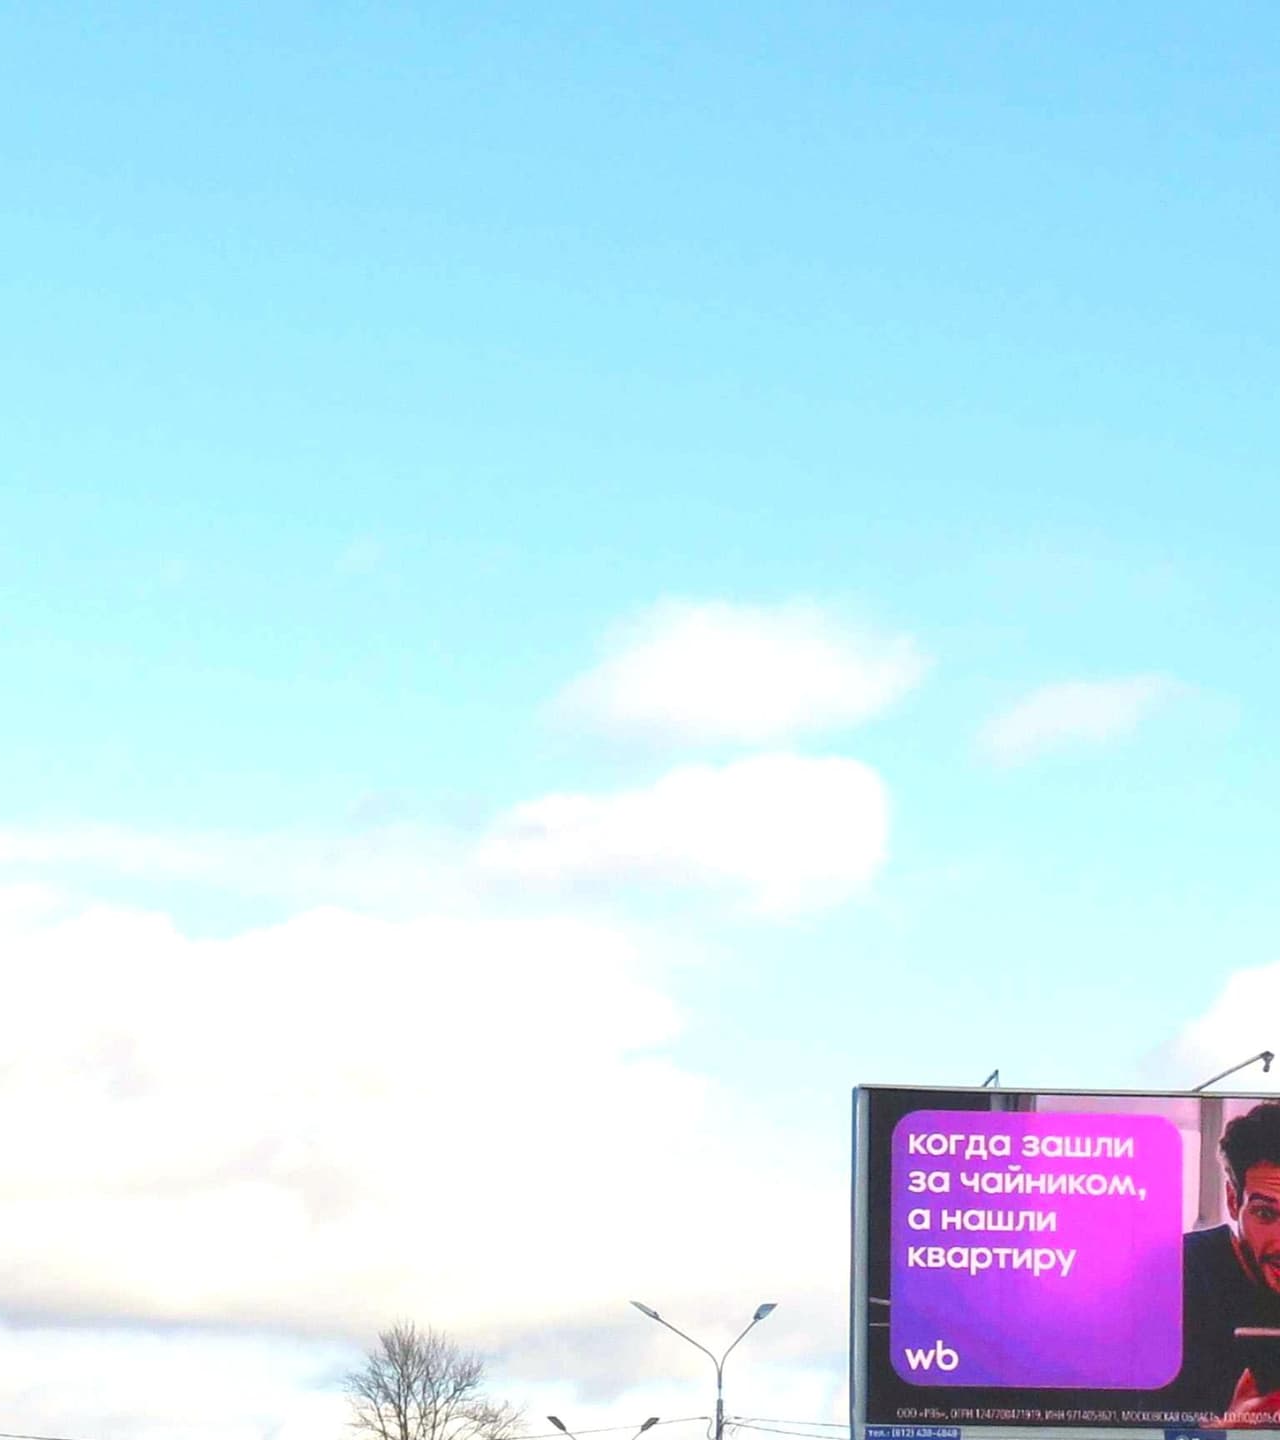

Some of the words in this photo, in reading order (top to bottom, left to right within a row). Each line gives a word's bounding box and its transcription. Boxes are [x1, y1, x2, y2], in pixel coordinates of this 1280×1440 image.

[908, 1133, 1011, 1160] когда
[1022, 1136, 1134, 1158] зашли
[907, 1170, 951, 1193] за
[959, 1164, 1147, 1201] чайником,
[907, 1208, 931, 1231] а
[941, 1208, 1057, 1232] нашли
[907, 1246, 1077, 1277] квартиру
[904, 1339, 959, 1371] wb
